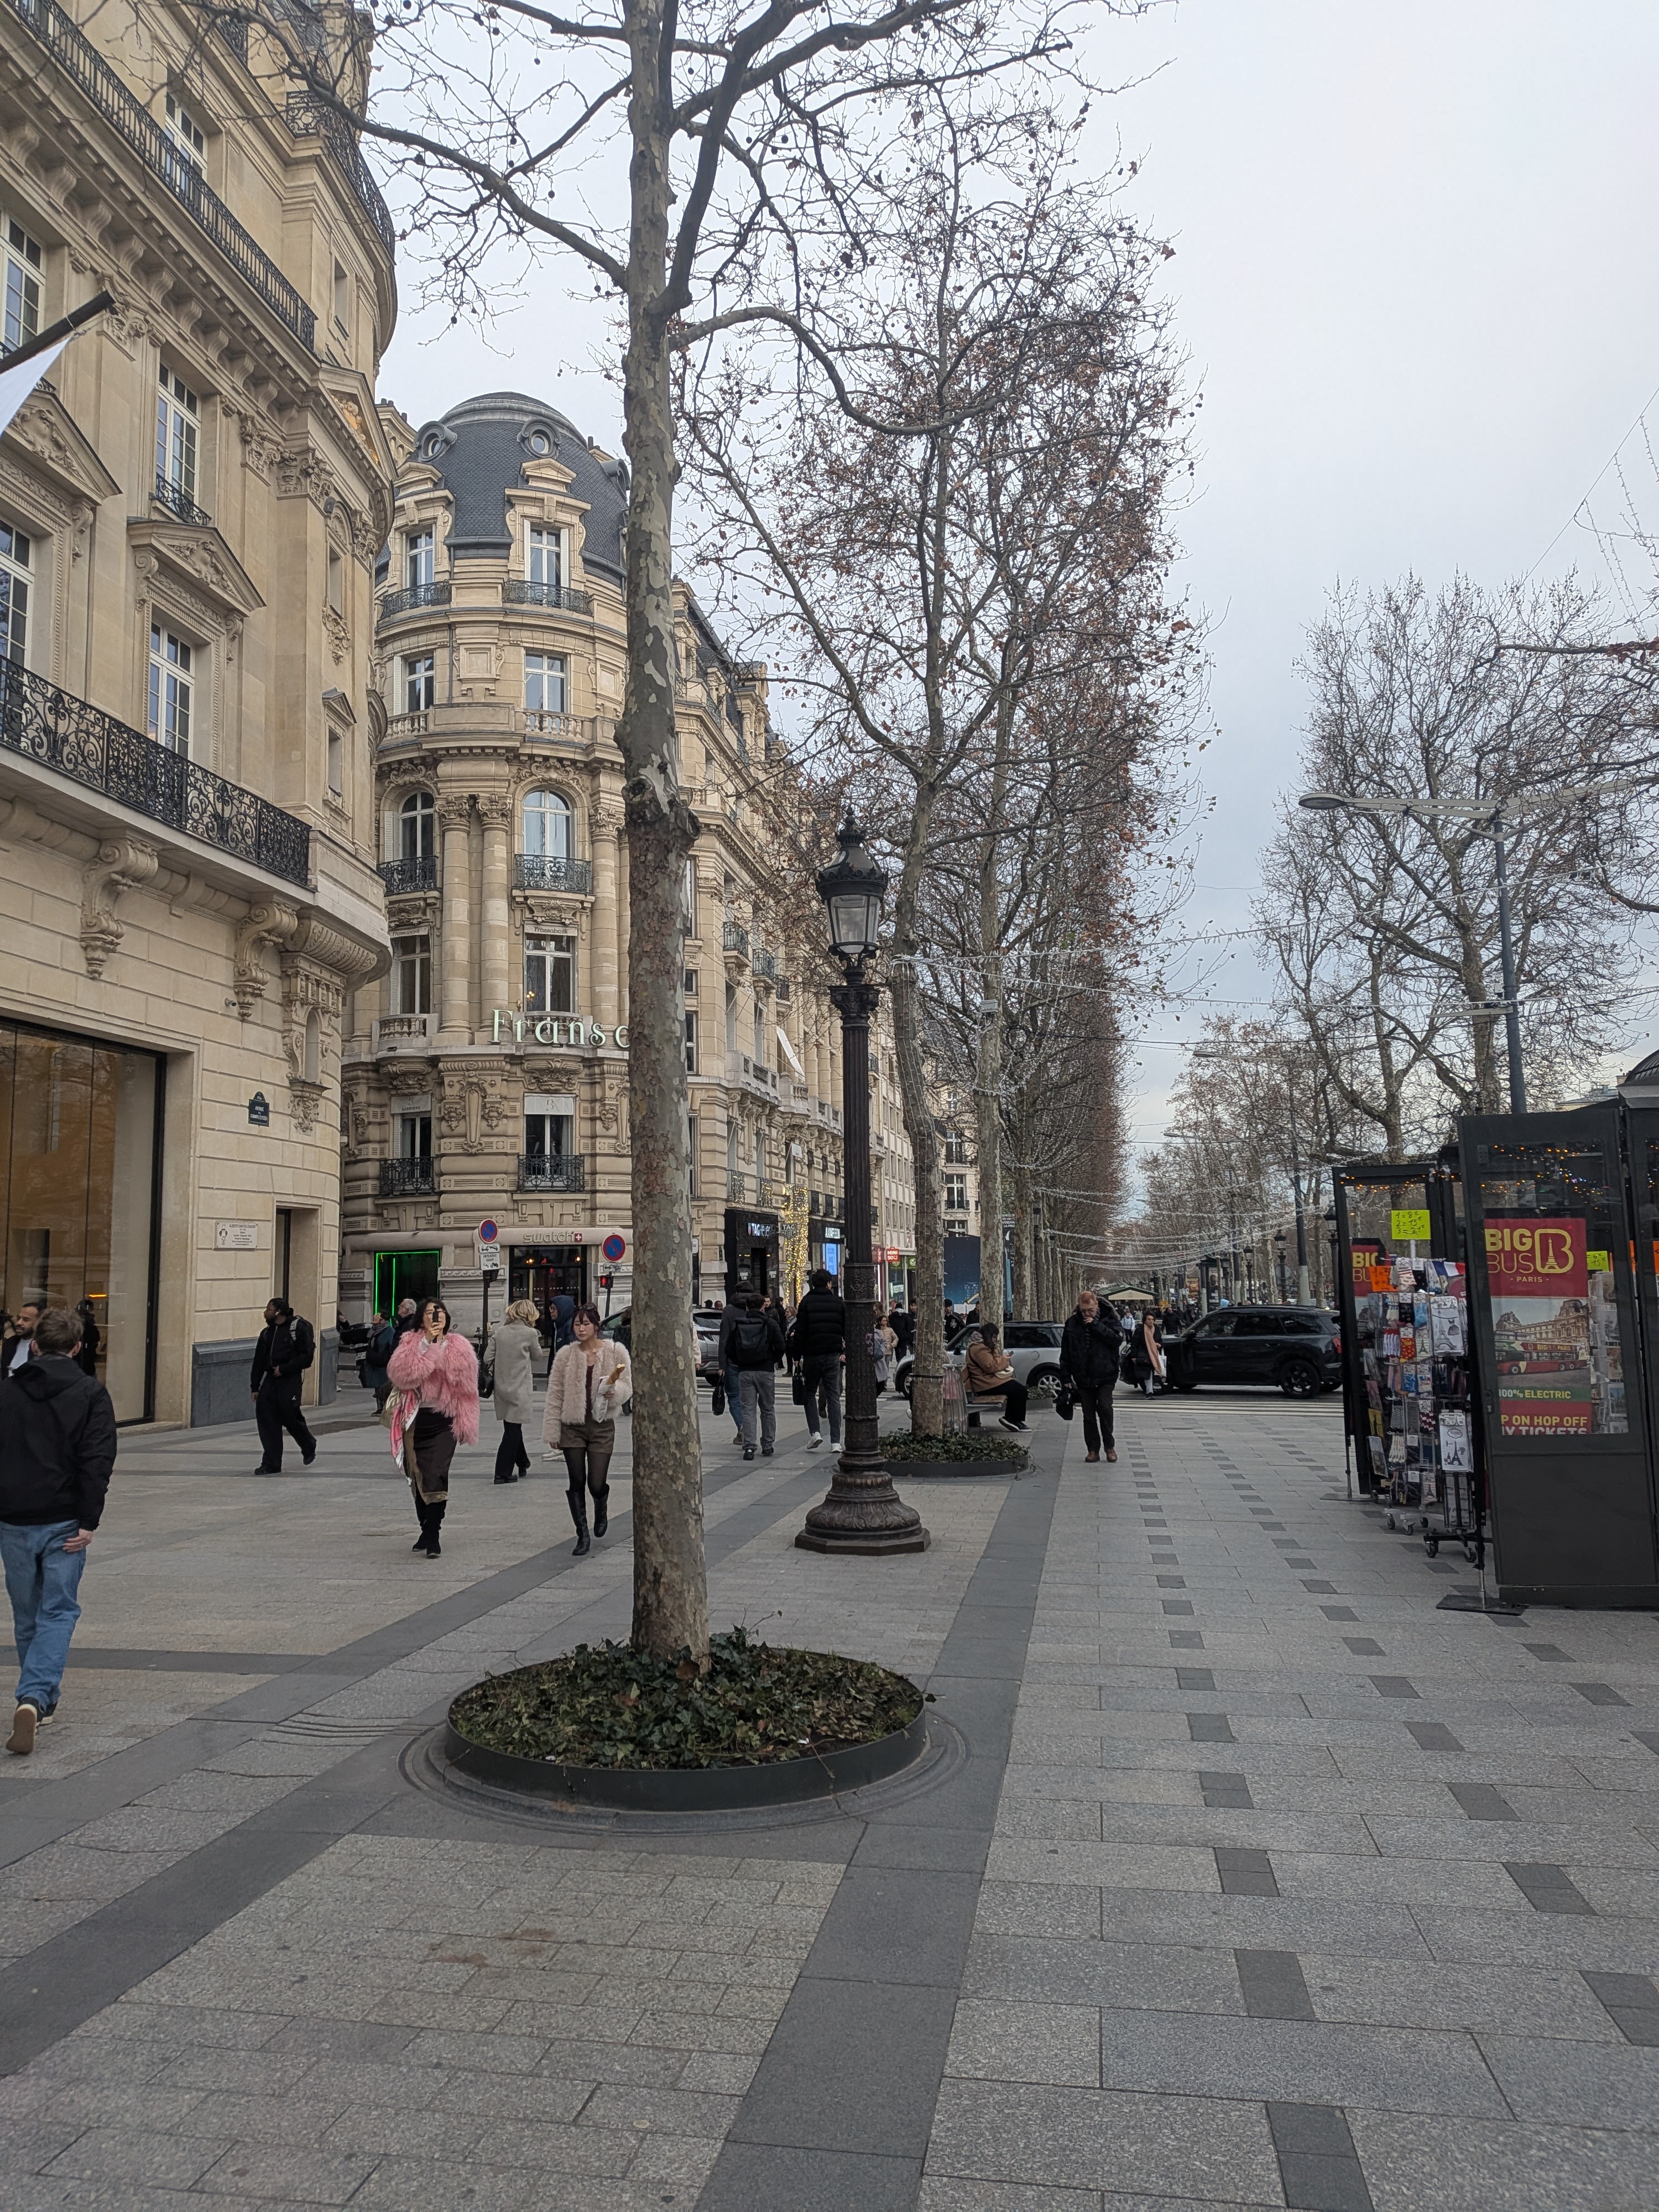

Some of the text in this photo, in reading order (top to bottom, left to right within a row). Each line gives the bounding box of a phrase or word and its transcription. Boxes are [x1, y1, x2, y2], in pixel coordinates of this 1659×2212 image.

[524, 1232, 574, 1243] swatch
[1485, 1229, 1532, 1251] BIG
[1486, 1253, 1534, 1274] BUS
[1499, 1389, 1571, 1399] 100% ELECTRIC
[1512, 1415, 1530, 1426] ON
[1534, 1416, 1560, 1426] HOP
[1563, 1416, 1588, 1427] OFF
